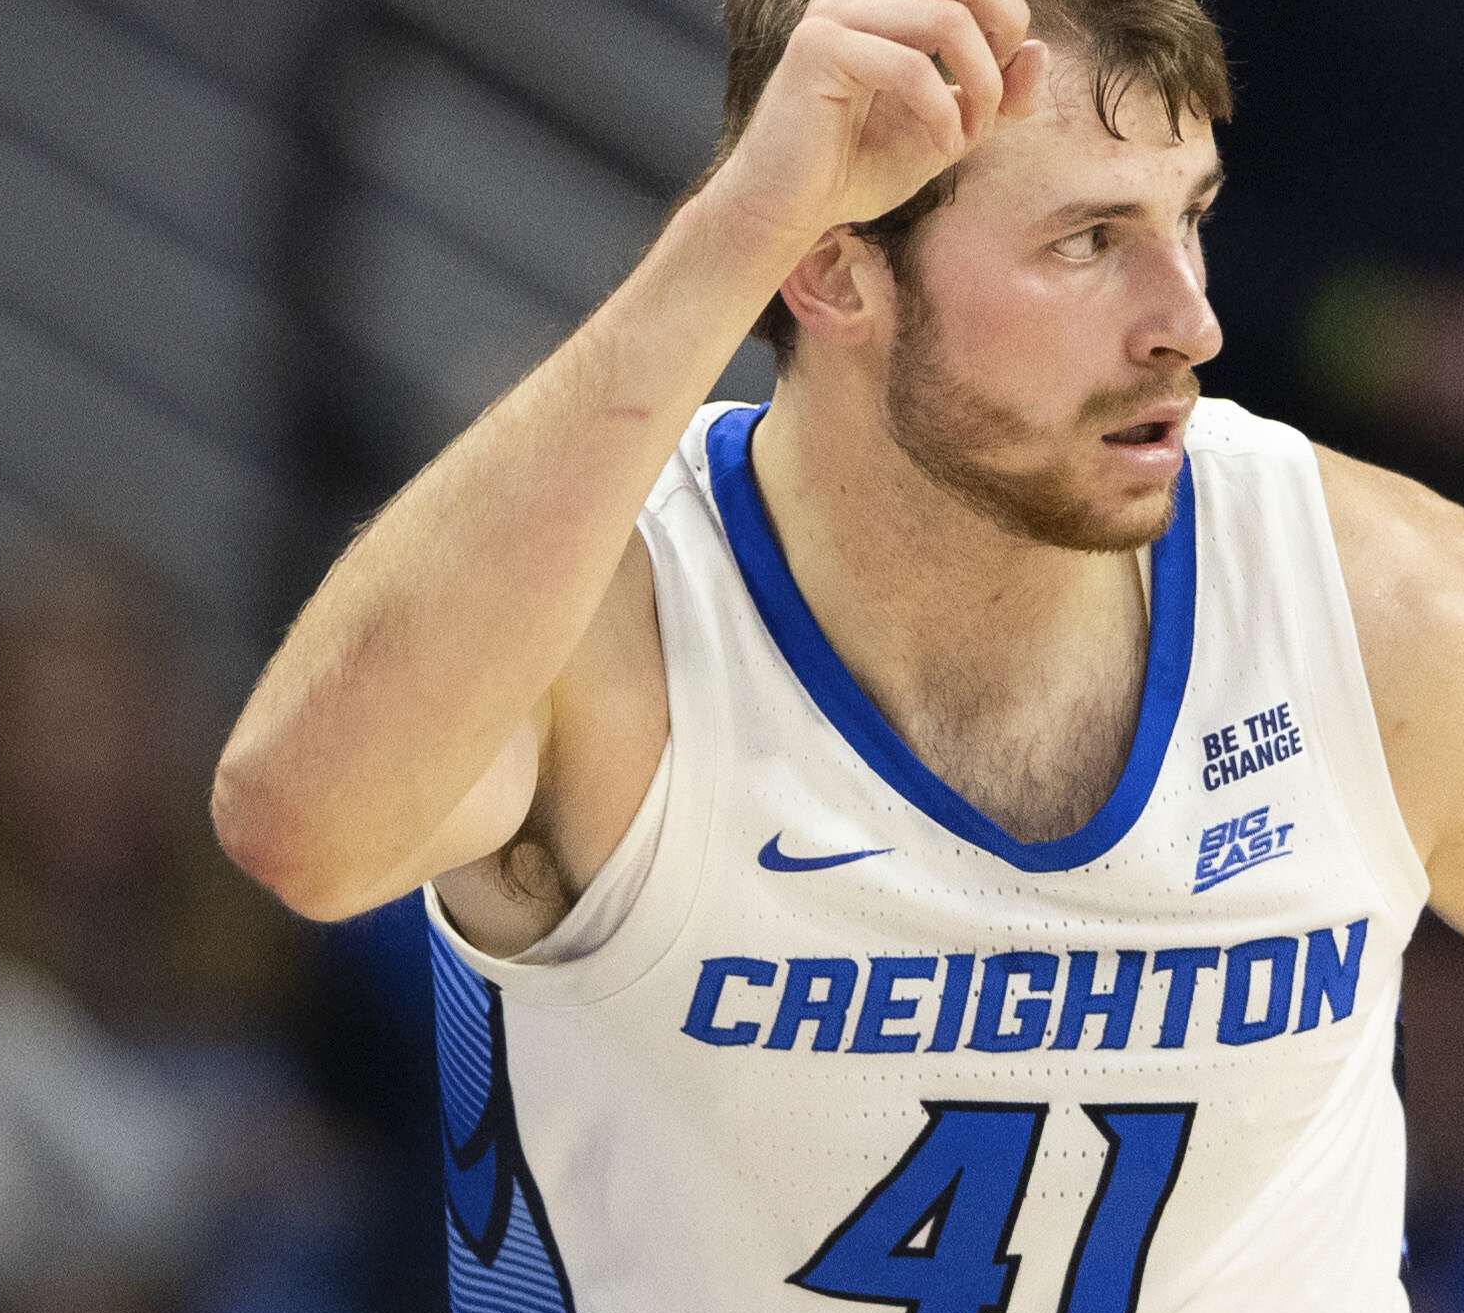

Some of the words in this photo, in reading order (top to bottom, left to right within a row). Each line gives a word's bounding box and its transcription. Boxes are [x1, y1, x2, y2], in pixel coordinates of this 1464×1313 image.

[1202, 724, 1240, 762] BE
[1243, 702, 1292, 743] THE
[1202, 727, 1303, 792] CHANGE
[1194, 823, 1294, 880] EAST
[1199, 805, 1270, 855] BIG
[680, 917, 1369, 1054] CREIGHTON
